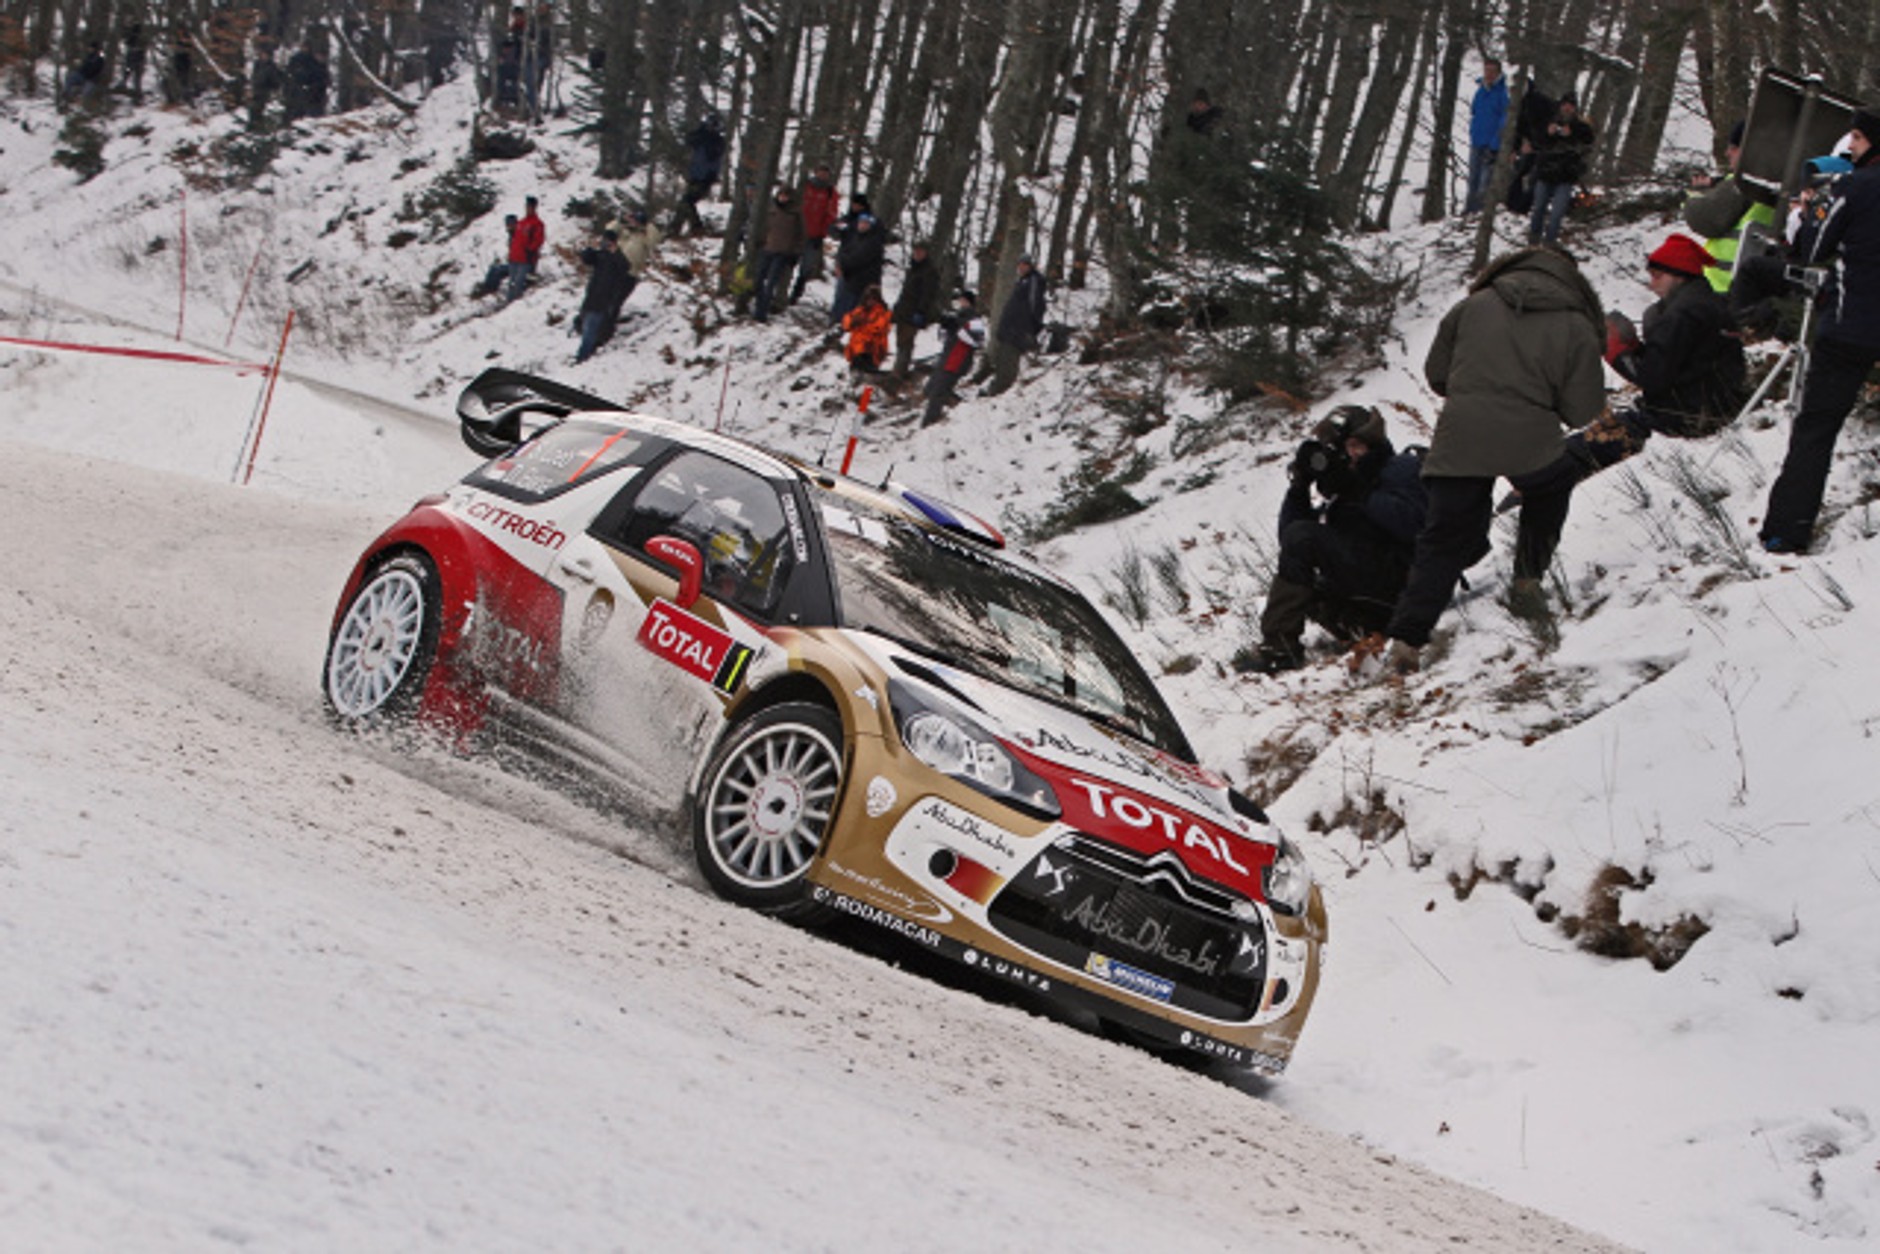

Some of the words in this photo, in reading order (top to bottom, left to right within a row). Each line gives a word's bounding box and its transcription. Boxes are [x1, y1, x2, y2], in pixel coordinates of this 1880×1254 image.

[649, 610, 714, 672] TOTAL
[1070, 778, 1250, 877] TOTAL
[1063, 894, 1126, 941] Abu
[1133, 916, 1221, 976] Dhabi
